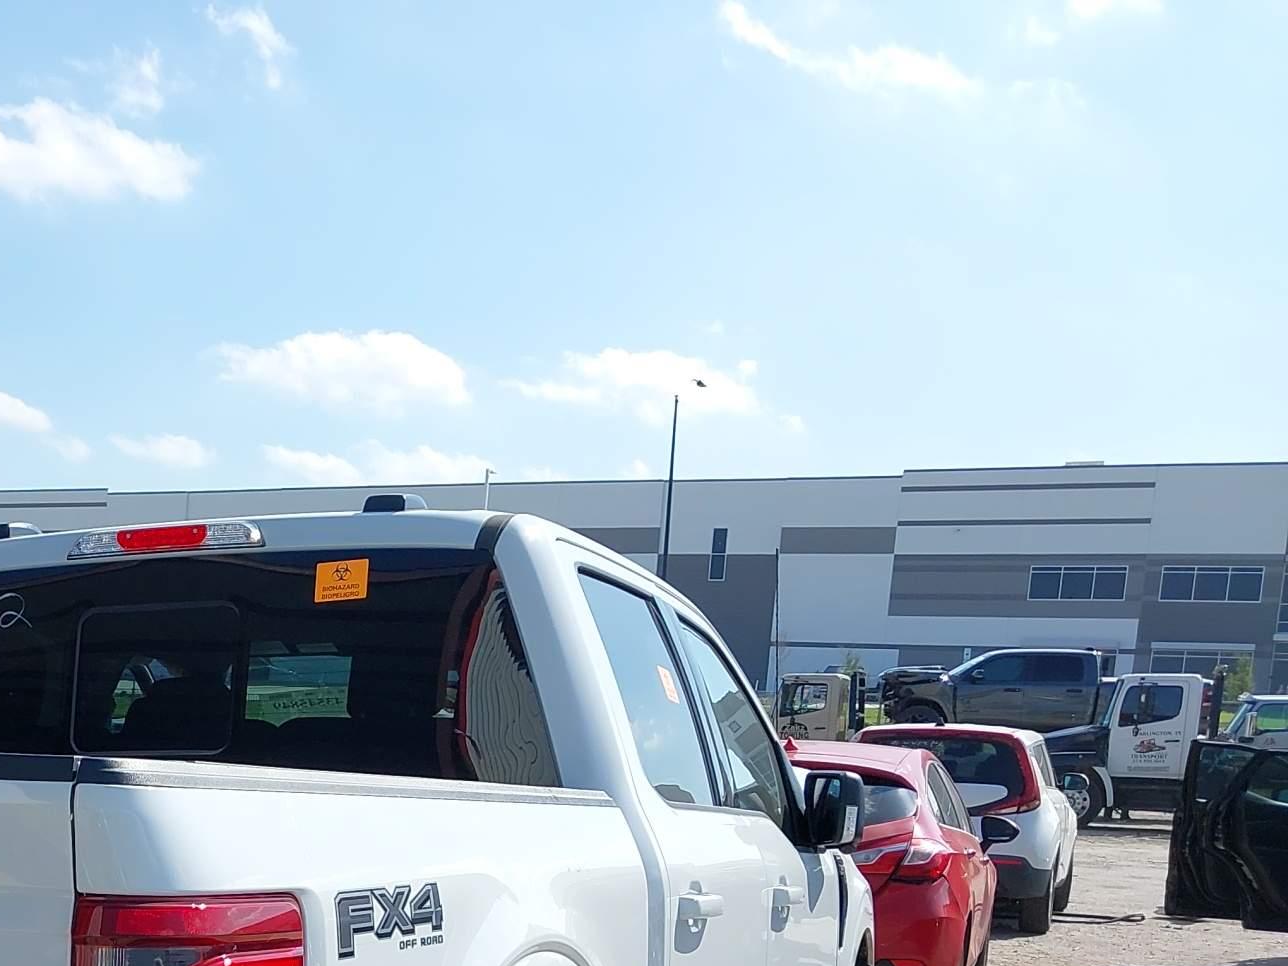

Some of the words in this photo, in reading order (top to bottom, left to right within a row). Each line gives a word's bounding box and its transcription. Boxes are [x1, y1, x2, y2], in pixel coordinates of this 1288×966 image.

[334, 882, 443, 960] FX4
[399, 938, 417, 951] OFF
[420, 934, 444, 948] ROAD
